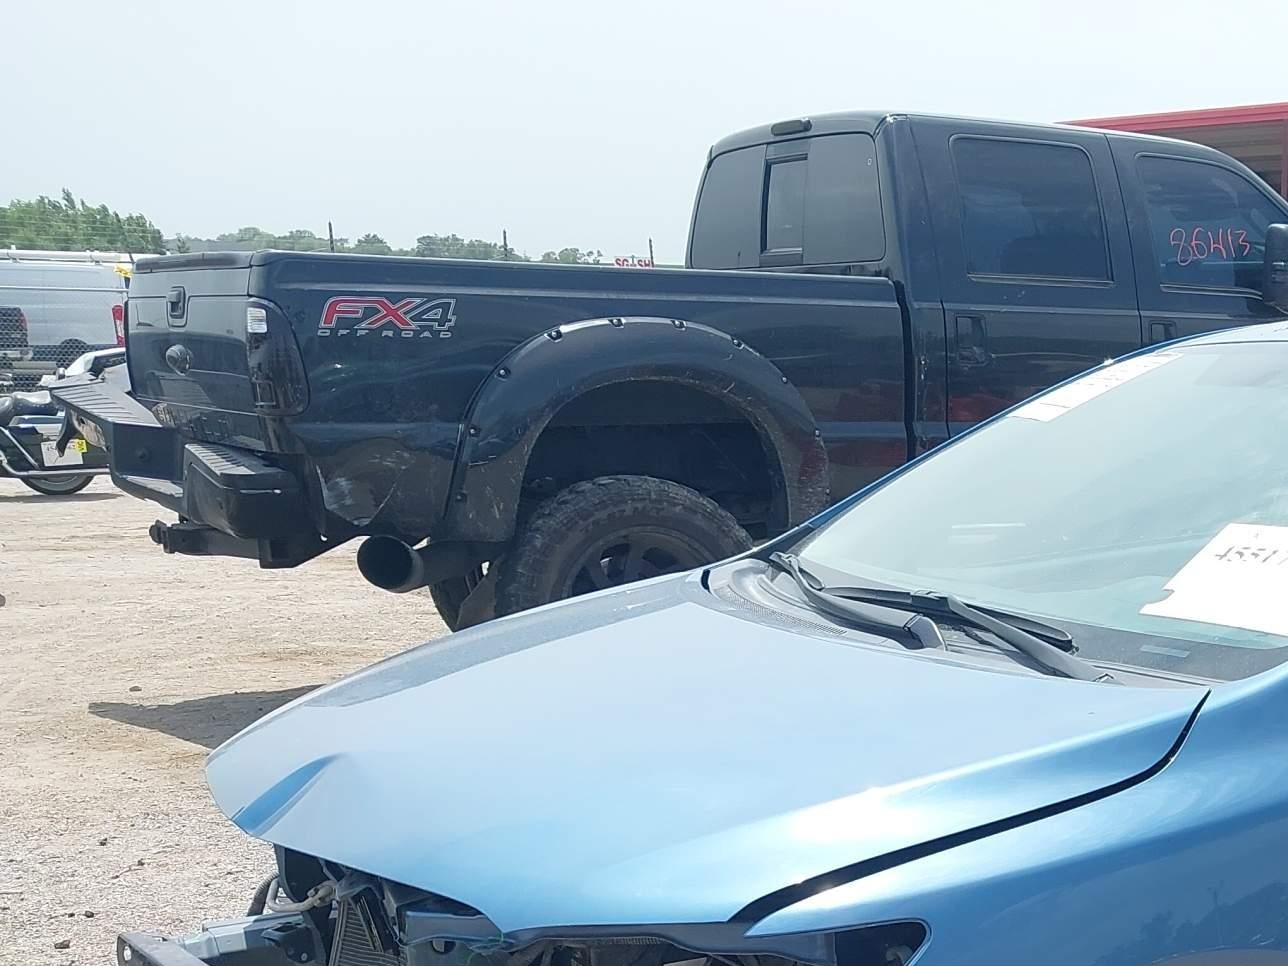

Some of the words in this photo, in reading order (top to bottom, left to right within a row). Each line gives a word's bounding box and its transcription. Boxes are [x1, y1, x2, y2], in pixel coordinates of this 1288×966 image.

[319, 296, 456, 331] FX4
[317, 329, 369, 337] OFF
[381, 330, 452, 338] ROAD
